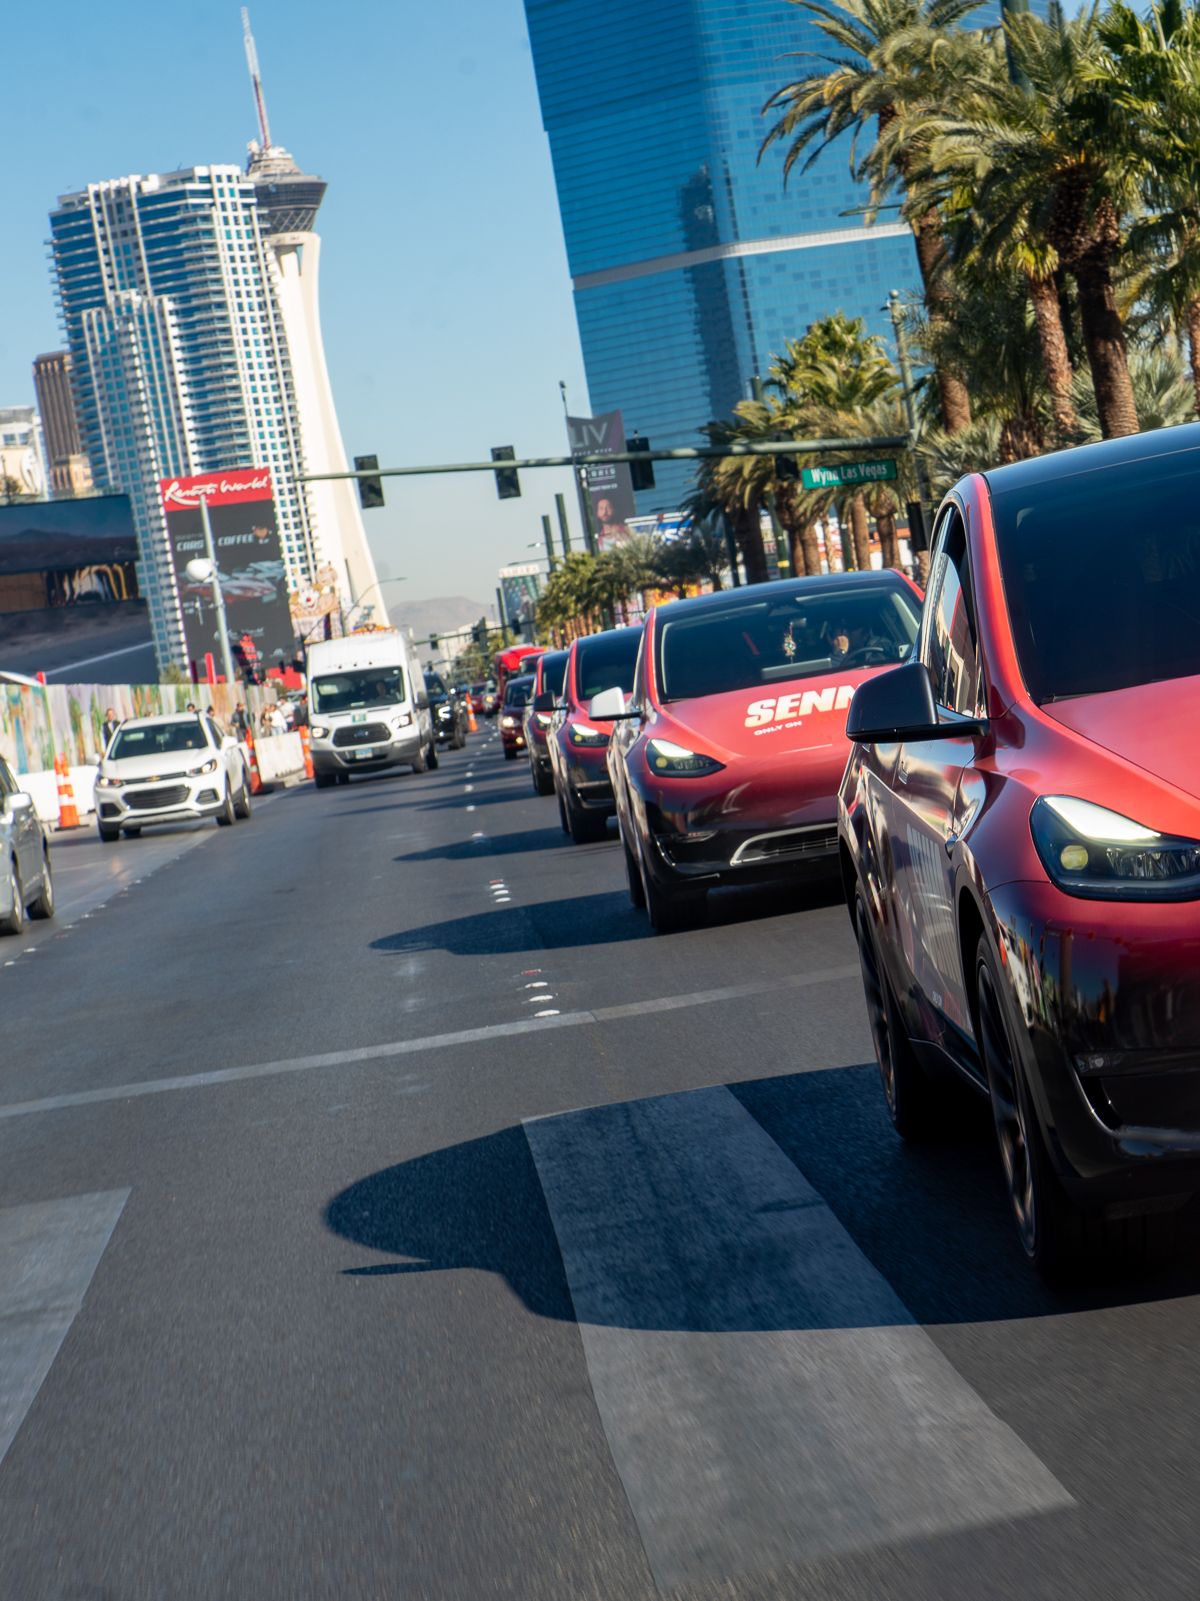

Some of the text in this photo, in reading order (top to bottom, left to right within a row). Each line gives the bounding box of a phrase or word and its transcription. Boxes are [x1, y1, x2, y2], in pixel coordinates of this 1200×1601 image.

[569, 422, 608, 448] LIV
[220, 476, 268, 493] World
[811, 464, 887, 486] Wynn Las Vegas
[218, 534, 254, 546] COFFEE
[744, 685, 857, 728] SENN
[754, 720, 802, 736] ONLY ON
